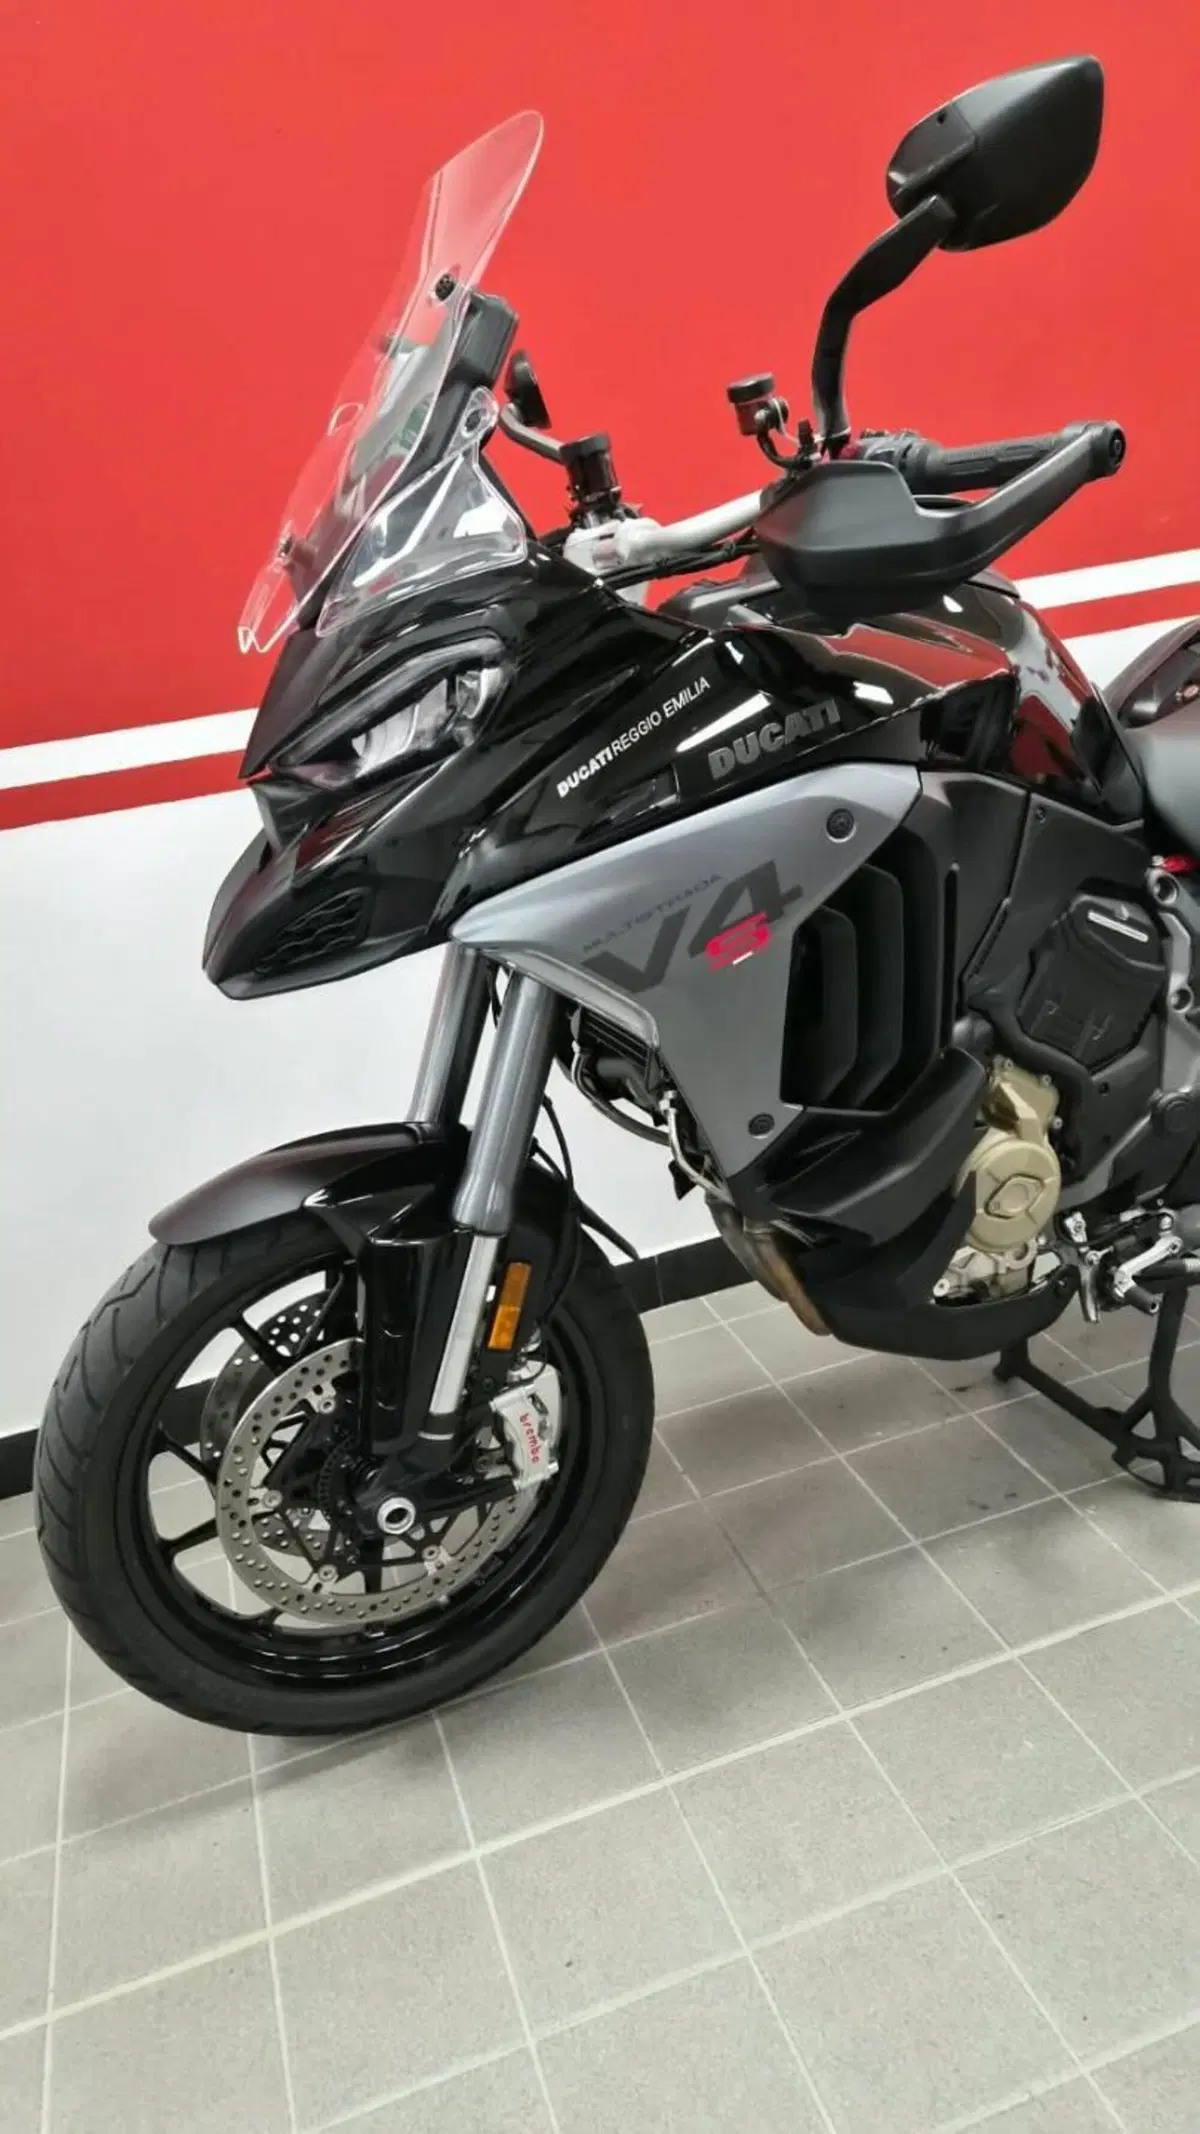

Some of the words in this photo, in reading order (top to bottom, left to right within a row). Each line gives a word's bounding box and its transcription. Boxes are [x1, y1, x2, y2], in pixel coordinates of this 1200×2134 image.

[556, 747, 613, 798] DUCATI
[611, 711, 662, 756] REGGIO
[663, 676, 711, 718] EMILIA
[708, 699, 841, 779] DUCATI
[580, 859, 804, 992] V4
[519, 1412, 541, 1464] brembo
